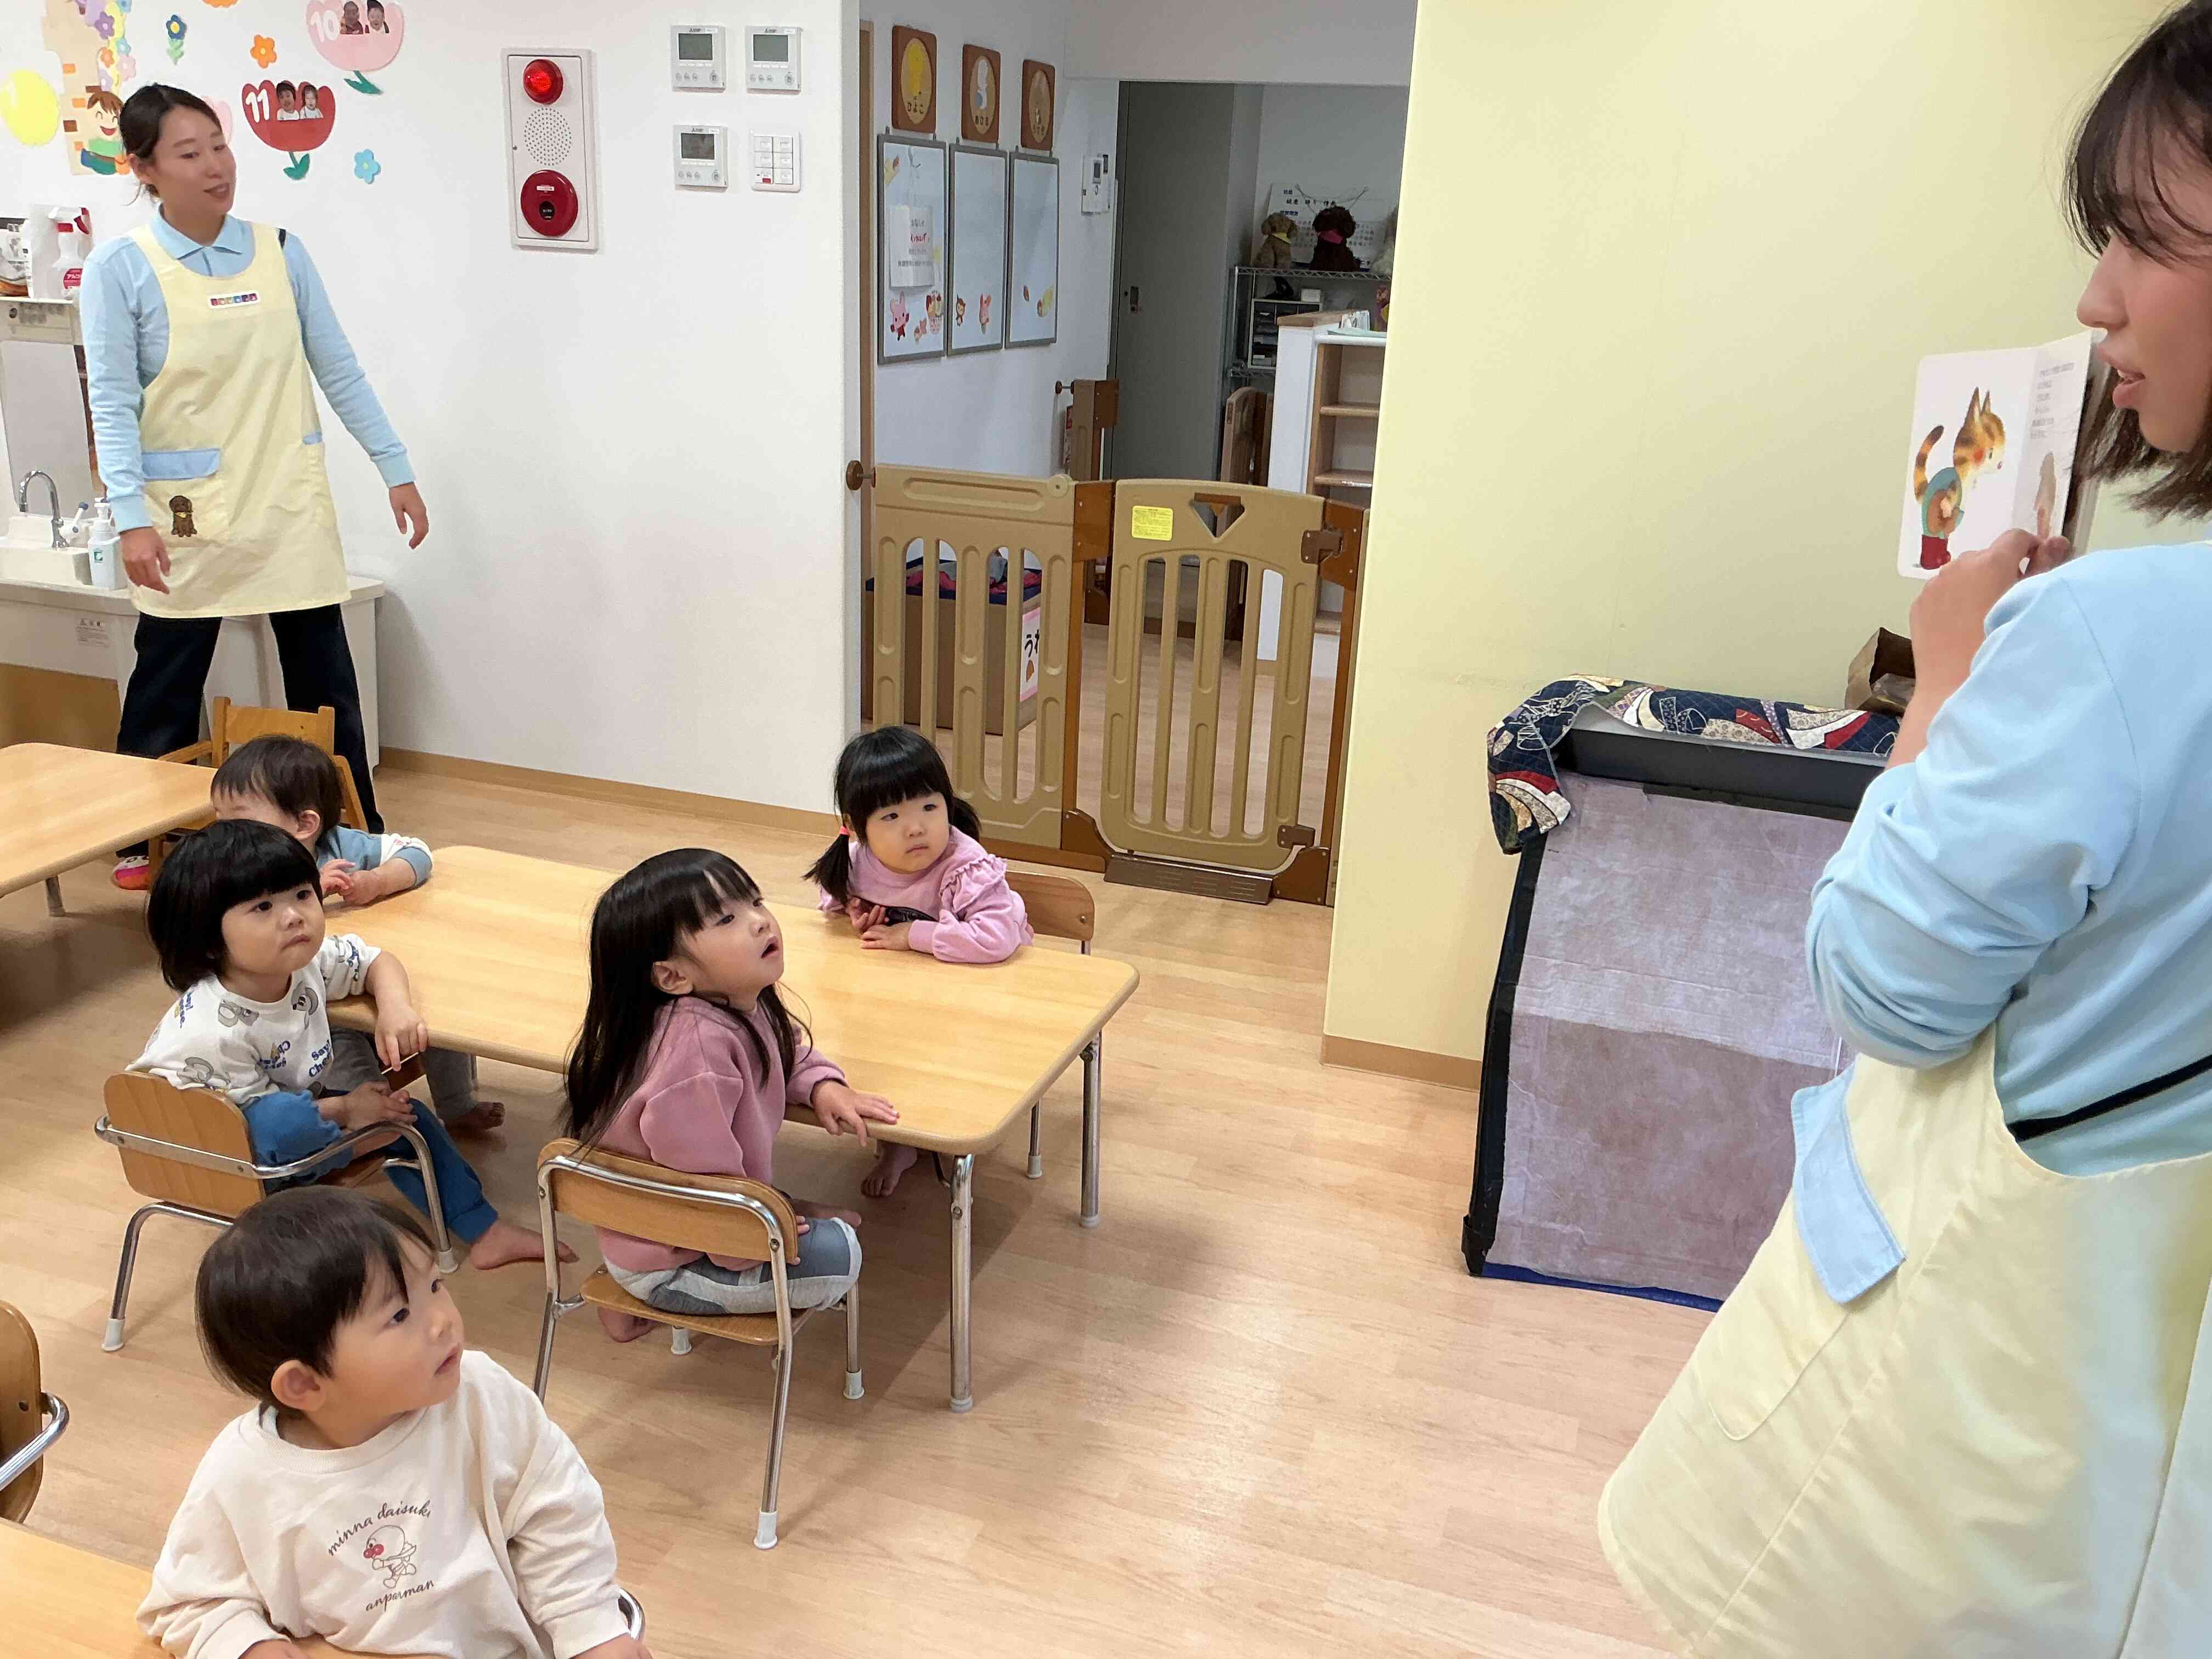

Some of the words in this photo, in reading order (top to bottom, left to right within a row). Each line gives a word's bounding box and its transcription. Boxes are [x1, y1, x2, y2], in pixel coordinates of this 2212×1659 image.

[309, 9, 340, 43] 10
[245, 88, 270, 123] 11
[907, 101, 923, 114] ひよこ
[328, 1517, 374, 1556] minna
